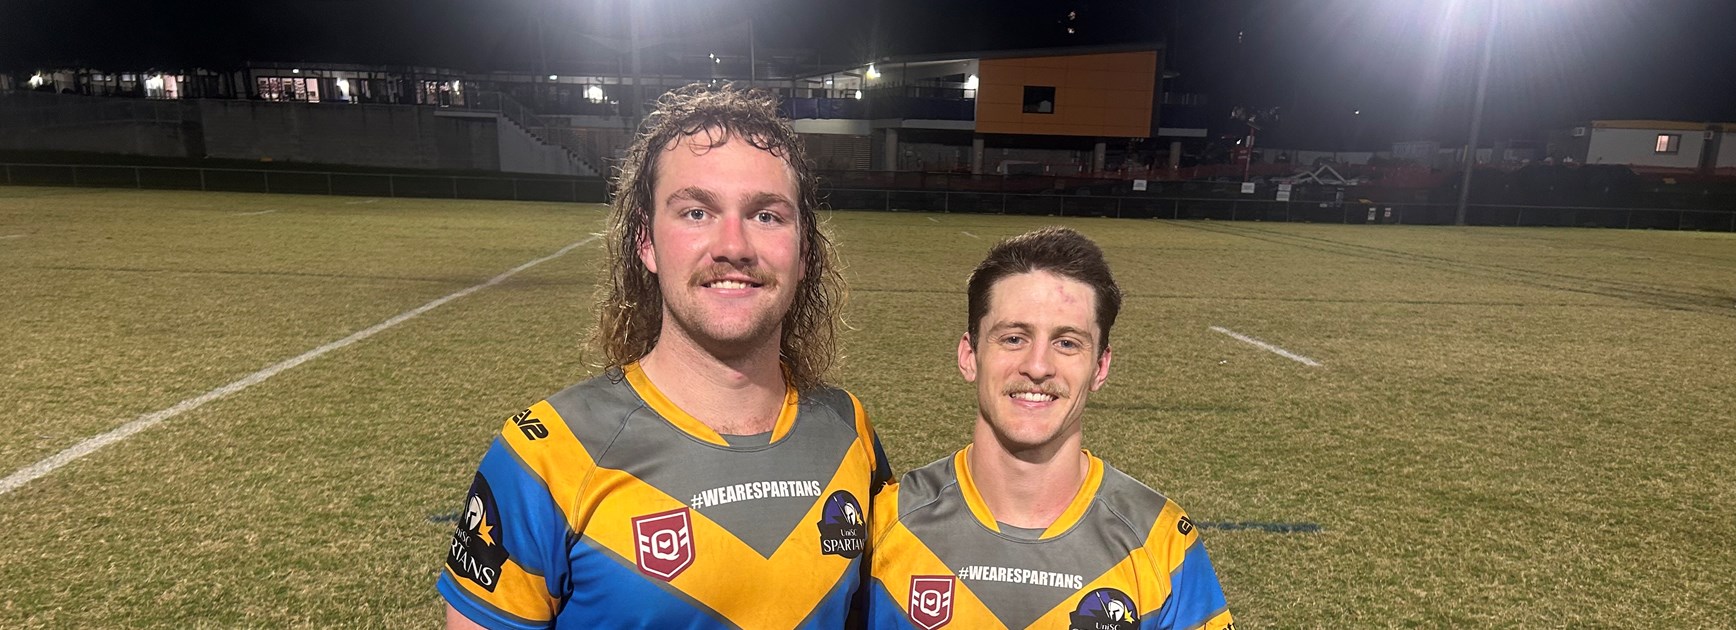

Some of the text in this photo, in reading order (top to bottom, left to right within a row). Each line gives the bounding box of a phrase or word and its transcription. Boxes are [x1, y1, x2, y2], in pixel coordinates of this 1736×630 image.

[690, 480, 821, 509] #WEARESPARTANS
[456, 527, 471, 548] niSC
[651, 529, 680, 561] Q
[823, 538, 865, 553] SPARTAN
[451, 536, 495, 586] RTANS
[958, 565, 1083, 590] #WEARESPARTANS
[920, 589, 942, 617] Q
